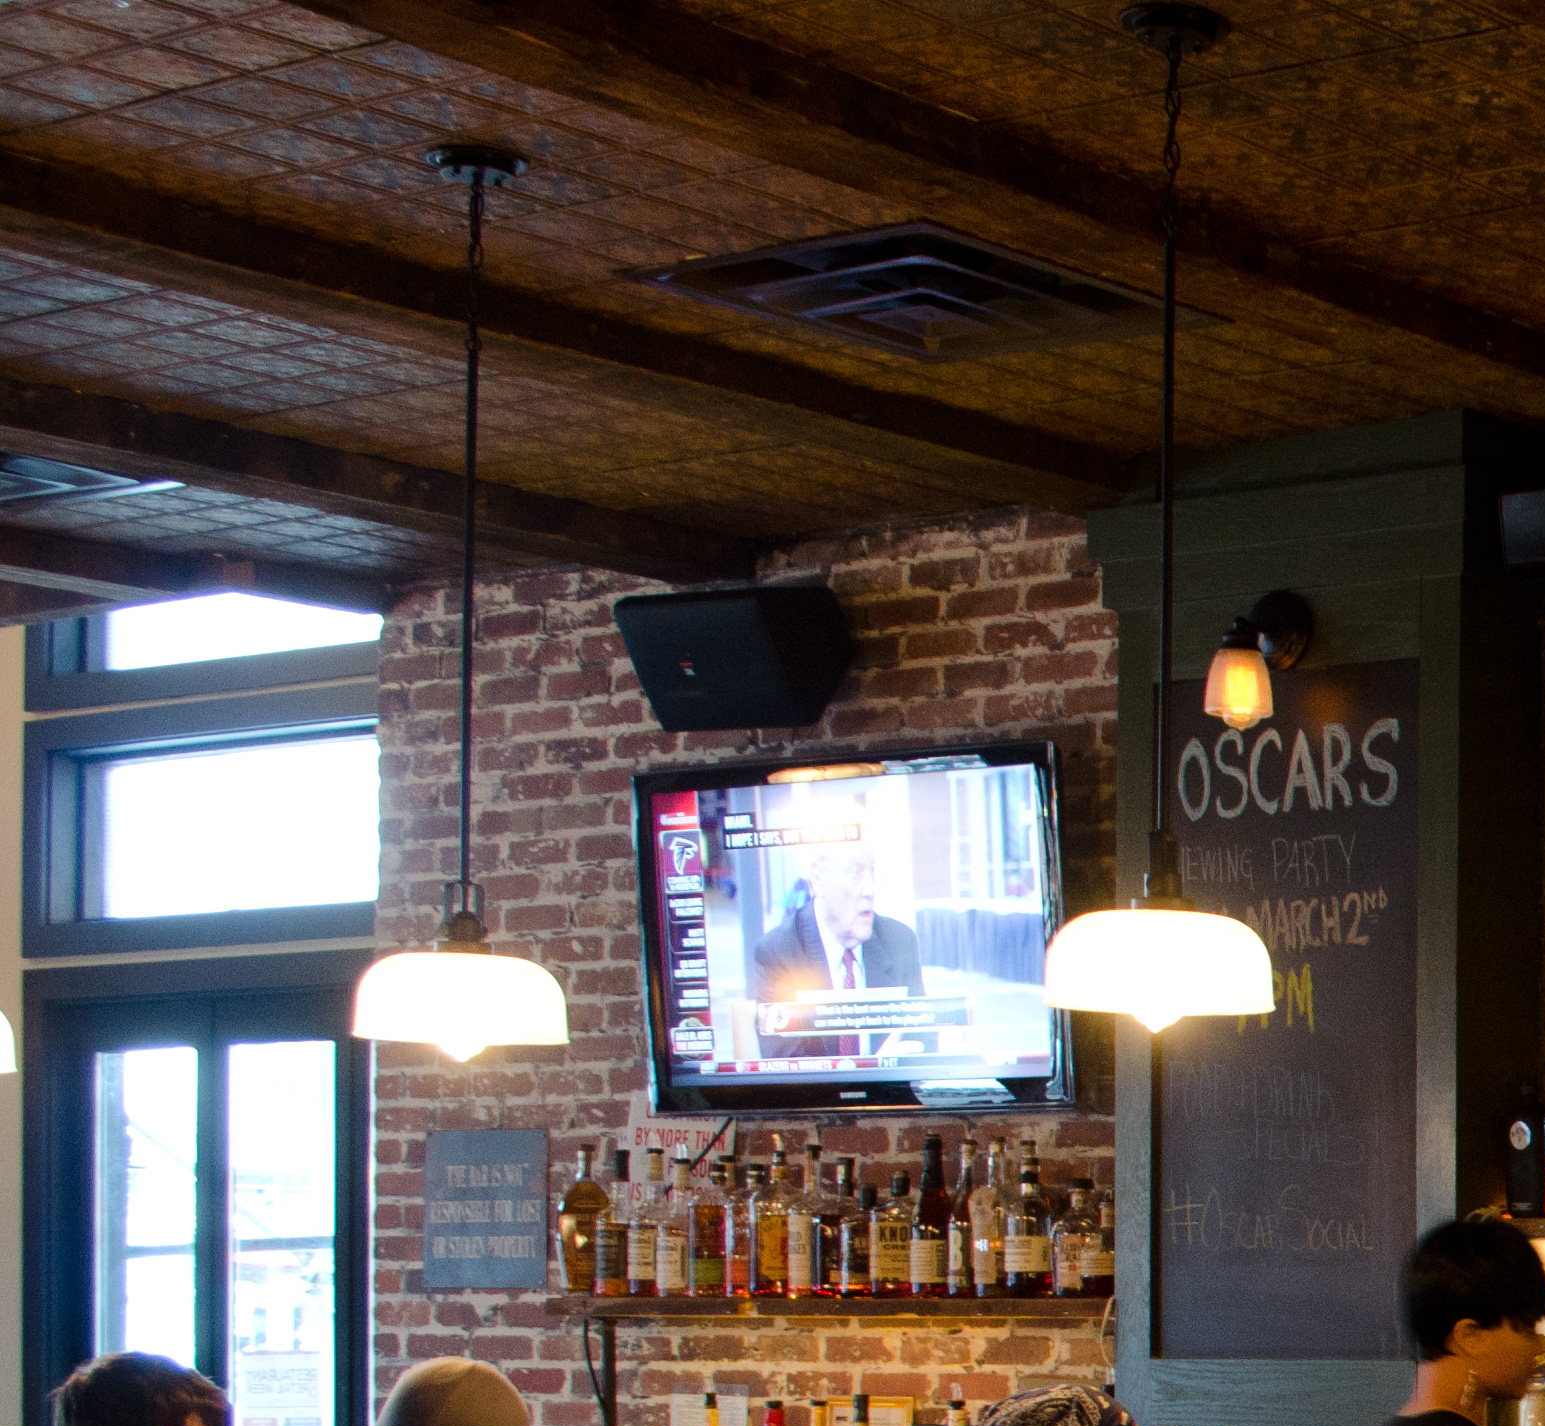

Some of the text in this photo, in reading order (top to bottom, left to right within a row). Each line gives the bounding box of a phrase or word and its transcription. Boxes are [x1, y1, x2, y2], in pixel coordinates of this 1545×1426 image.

[1177, 718, 1400, 822] OSCARS
[1179, 832, 1357, 892] IEWING PARTY
[634, 1127, 650, 1146] BY
